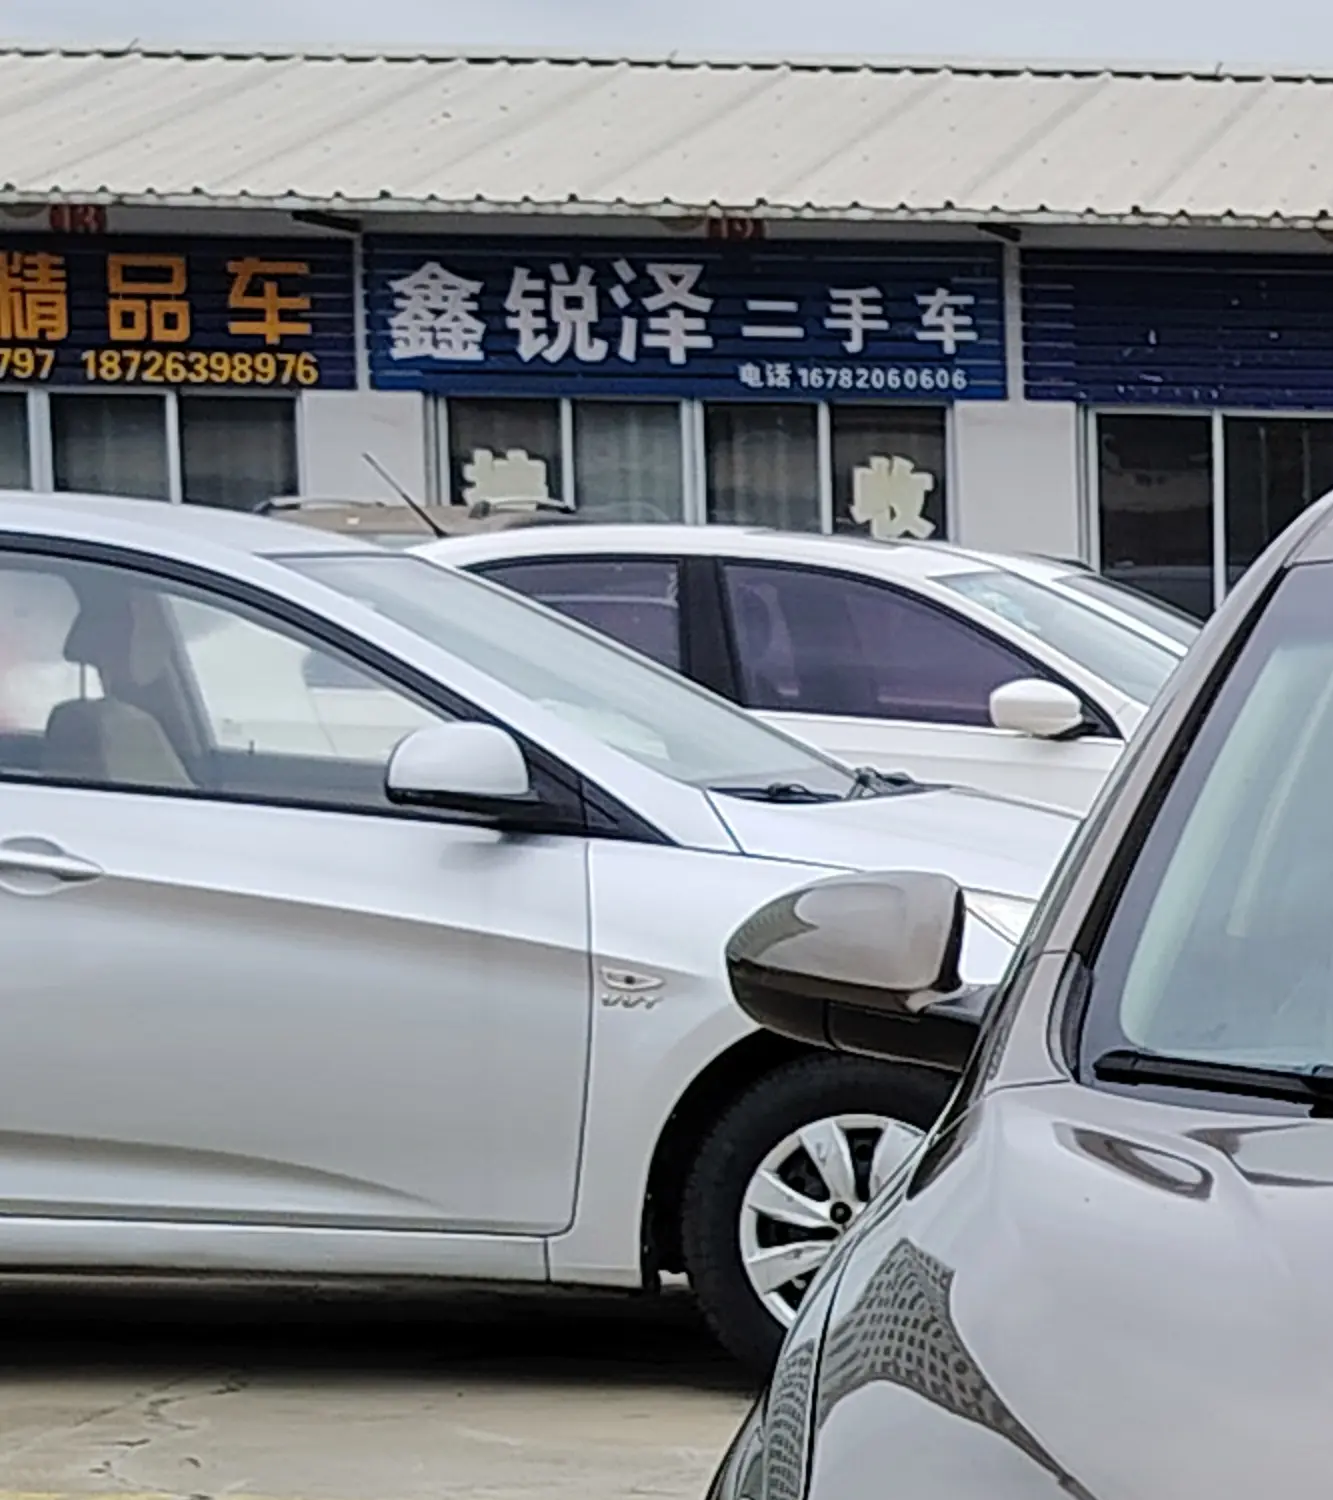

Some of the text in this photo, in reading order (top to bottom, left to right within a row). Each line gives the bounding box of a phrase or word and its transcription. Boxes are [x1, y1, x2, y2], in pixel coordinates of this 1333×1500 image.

[0, 252, 312, 345] 精品车
[387, 258, 980, 366] 鑫锐泽 二手车
[80, 350, 320, 385] 18726398976
[738, 361, 969, 391] 电话 16782060606
